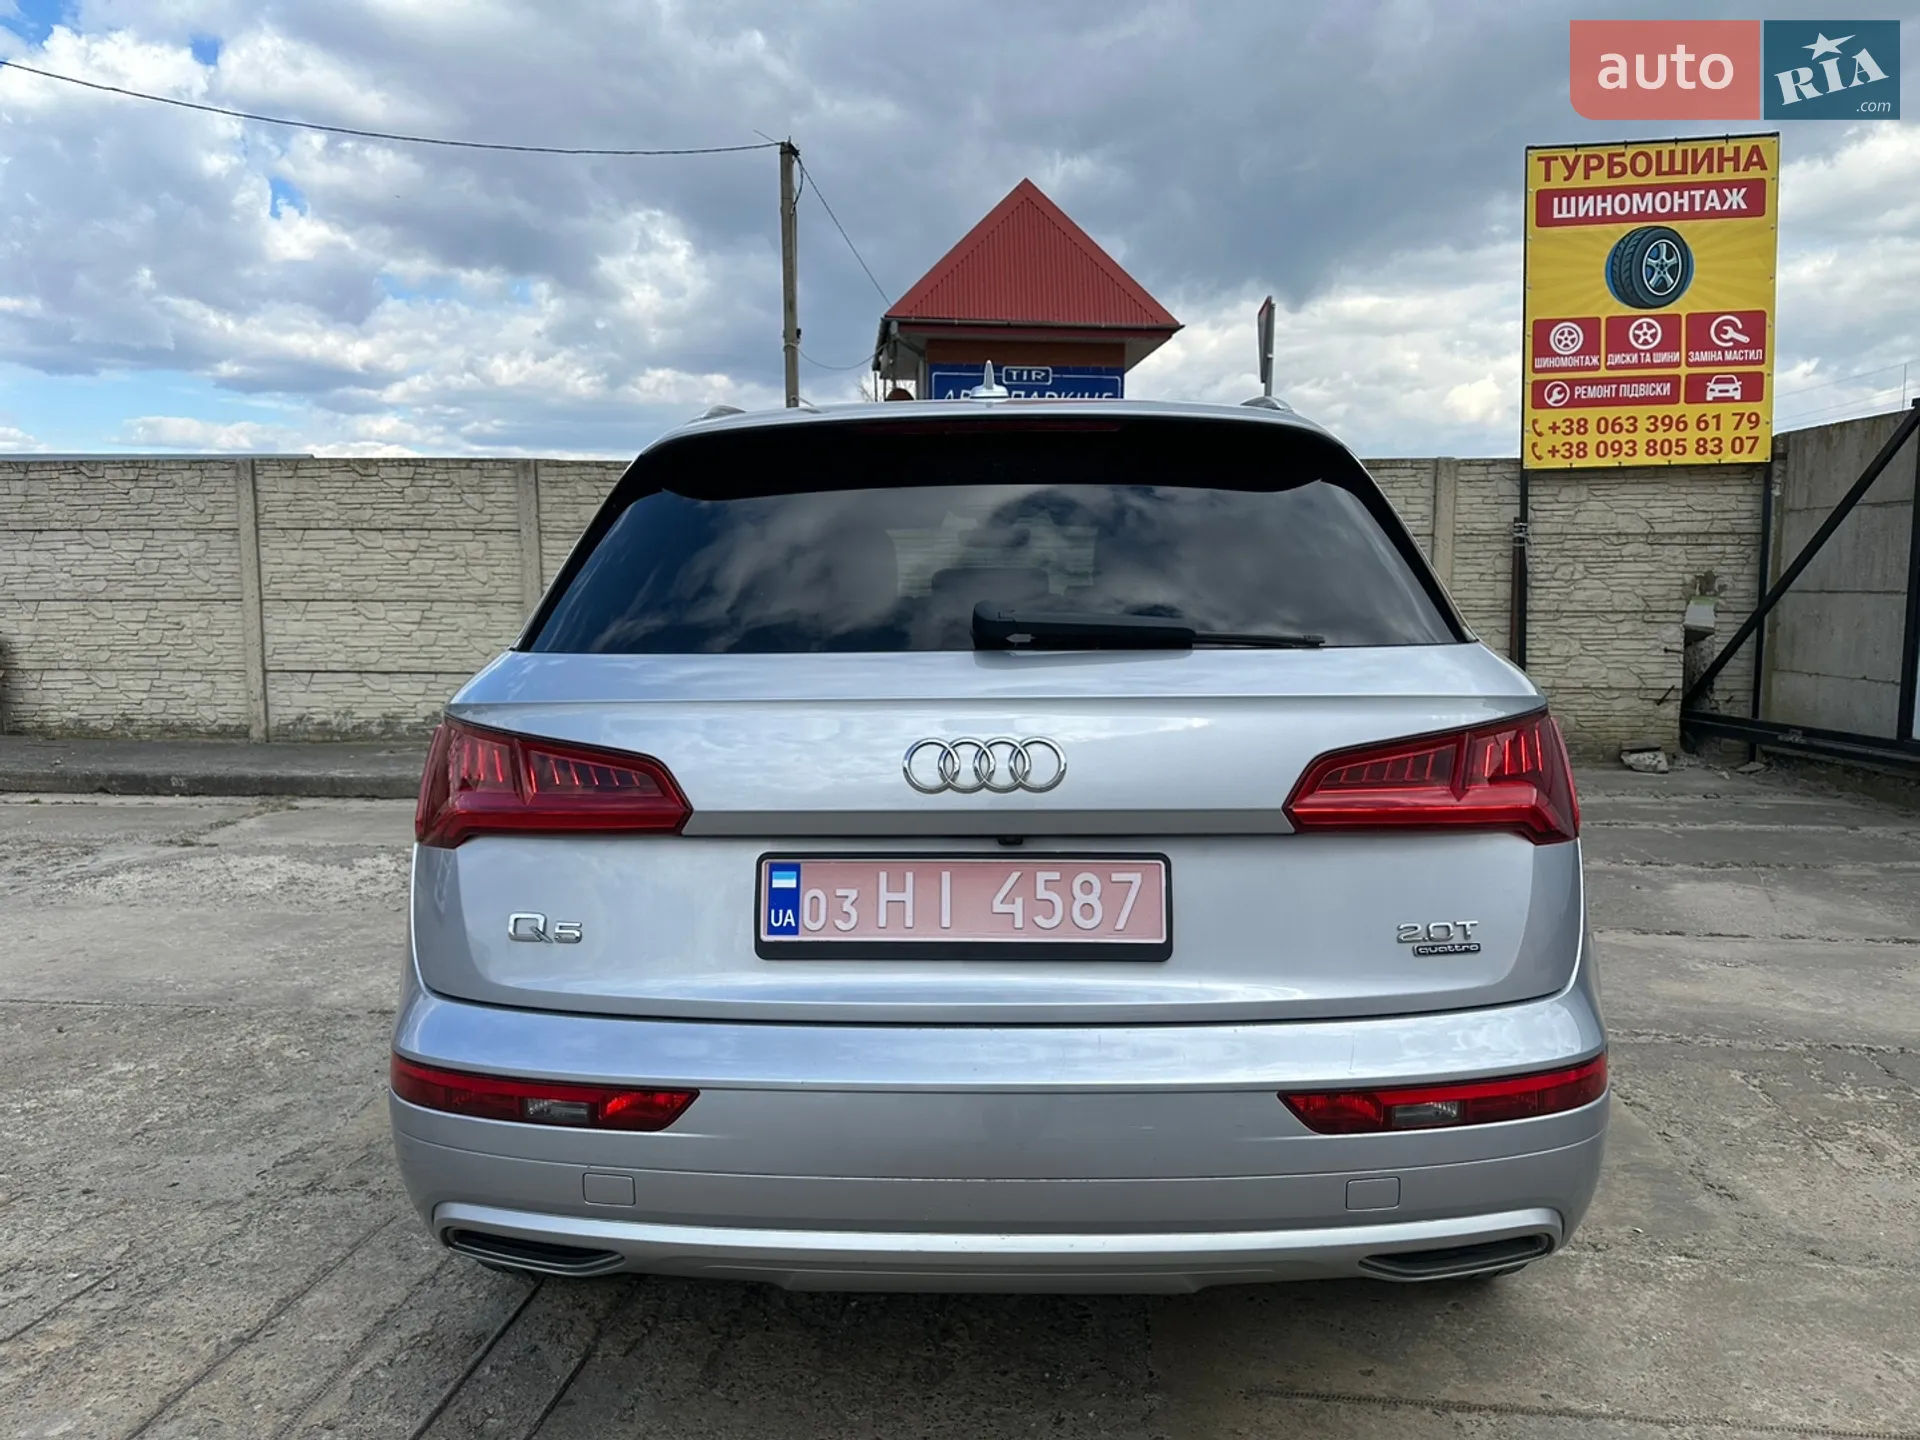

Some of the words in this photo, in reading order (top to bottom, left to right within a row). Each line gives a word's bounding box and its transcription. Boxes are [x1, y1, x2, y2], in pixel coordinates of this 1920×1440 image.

[1537, 144, 1768, 182] ТУРБОШИНА
[1552, 187, 1748, 219] ШИНОМОНТАЖ
[1534, 354, 1600, 368] ШИНОМОНТАЖ
[1606, 353, 1638, 366] ДИСКИ
[1639, 352, 1651, 364] ТА
[1652, 351, 1680, 364] ШИНИ
[1688, 350, 1723, 363] ЗАМІНА
[1724, 349, 1763, 361] МАСТИЛ
[1007, 370, 1047, 381] TIR
[1574, 384, 1618, 399] РЕМОНТ
[1619, 382, 1671, 398] ПІДВІСКИ
[1548, 417, 1589, 436] +38
[1596, 415, 1639, 435] 063
[1645, 413, 1689, 433] 396
[1695, 413, 1722, 431] 61
[1731, 411, 1761, 431] 79
[1547, 441, 1588, 460] +38
[1595, 439, 1638, 458] 093
[1644, 437, 1688, 457] 805
[1695, 437, 1723, 456] 83
[1730, 435, 1760, 454] 07
[770, 908, 796, 928] UA
[802, 888, 859, 932] 03
[991, 871, 1144, 931] 4587
[508, 912, 583, 944] Q5
[1397, 920, 1479, 943] 2.0T
[1417, 943, 1480, 954] quattro
